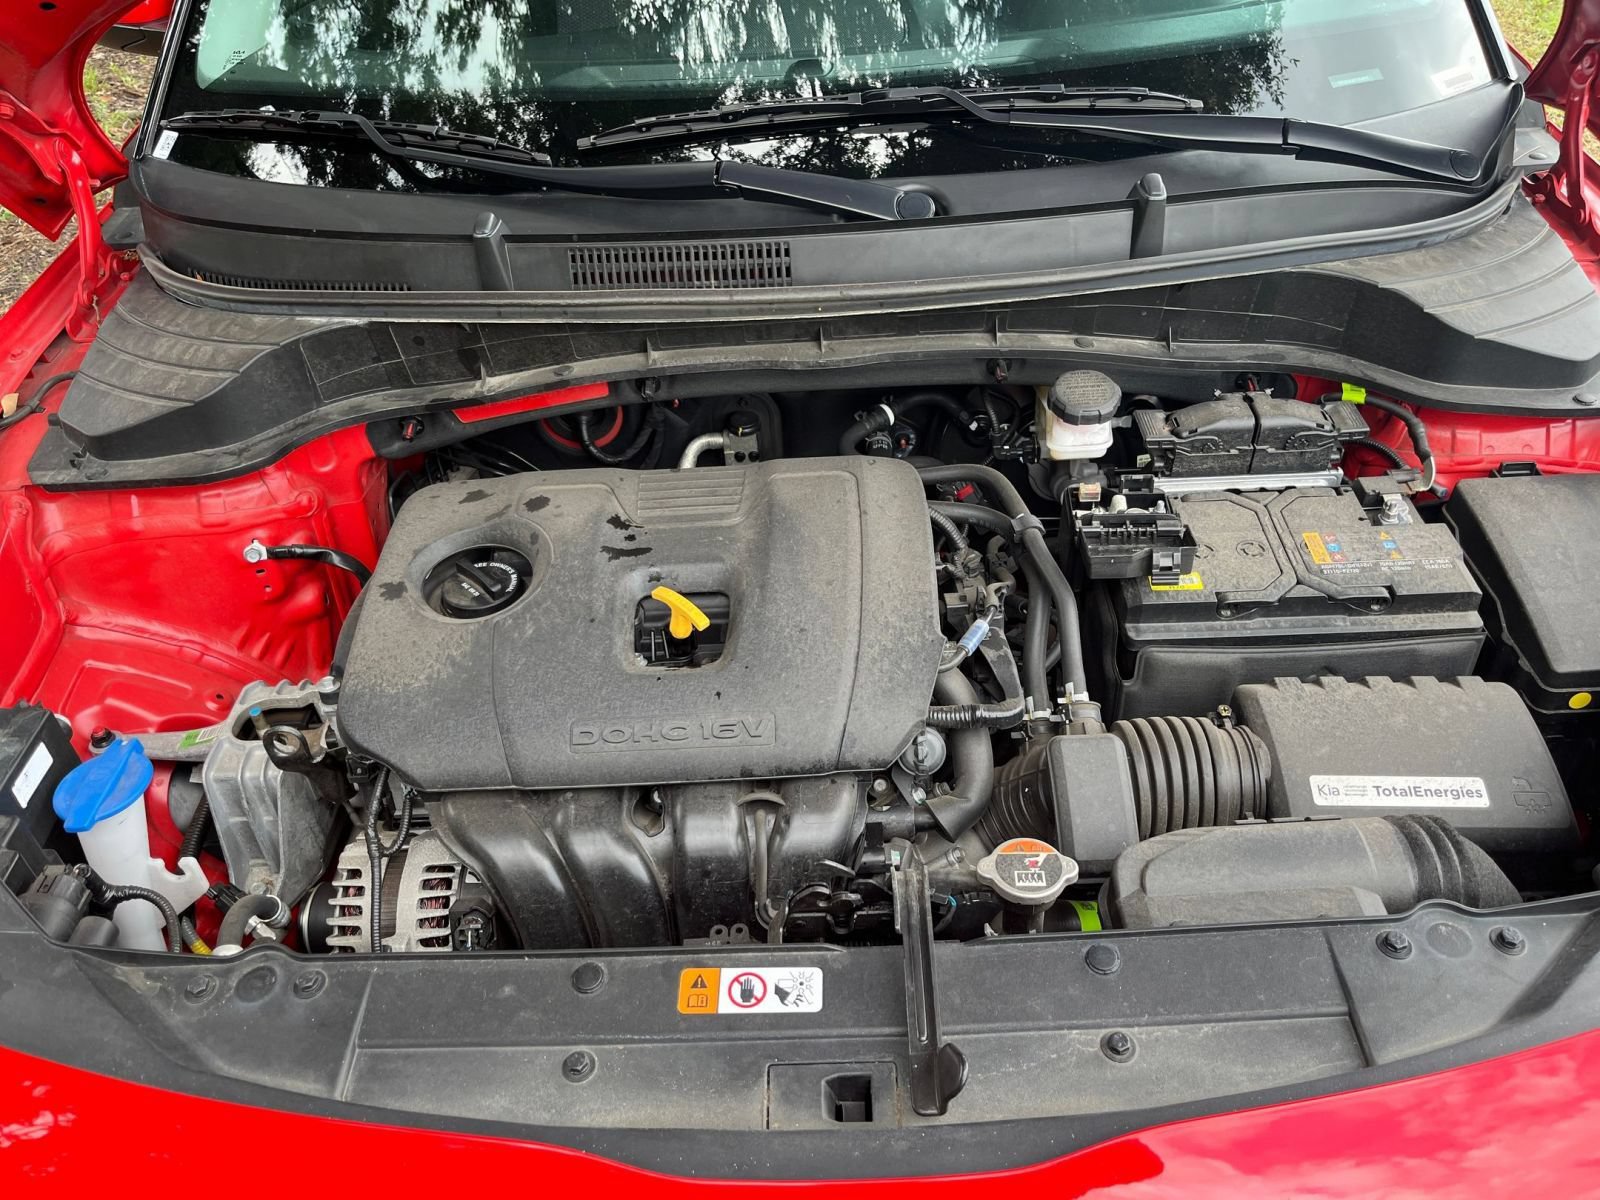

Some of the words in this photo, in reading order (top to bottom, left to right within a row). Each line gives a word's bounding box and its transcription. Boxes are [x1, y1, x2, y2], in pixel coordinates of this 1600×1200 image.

[572, 721, 690, 746] DOHC
[699, 718, 771, 740] 16V
[1316, 784, 1341, 797] Kia
[1372, 784, 1483, 800] TotalEnergies
